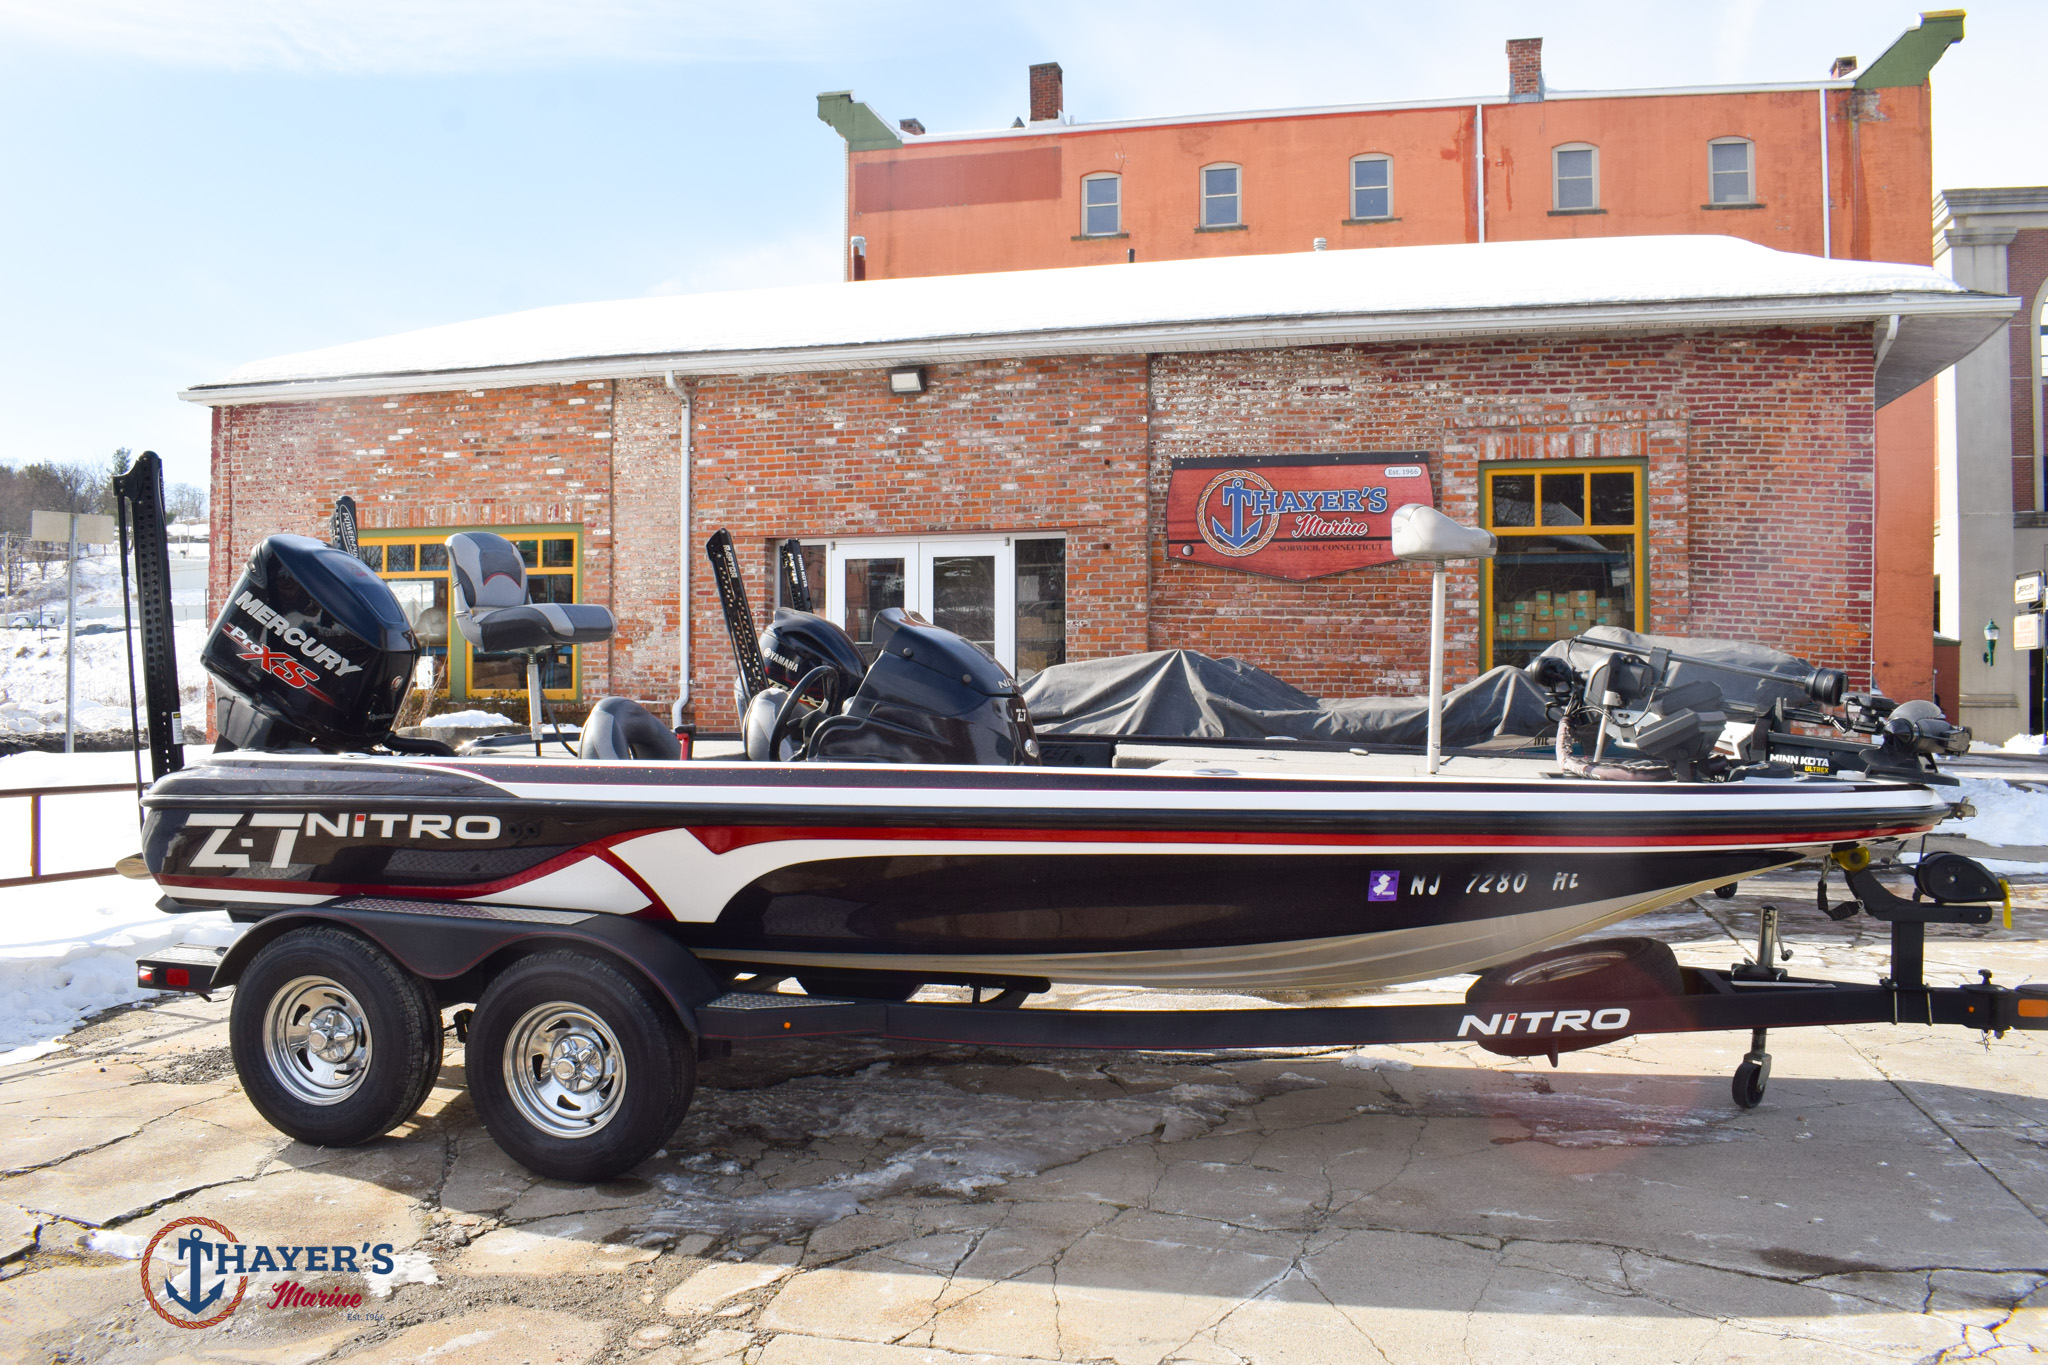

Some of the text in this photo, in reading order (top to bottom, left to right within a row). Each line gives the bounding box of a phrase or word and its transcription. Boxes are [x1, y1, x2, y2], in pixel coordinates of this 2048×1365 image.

[1291, 514, 1369, 538] Marine
[1322, 543, 1384, 551] CONNECTICUT
[235, 591, 363, 677] MERCURY
[769, 650, 799, 673] YAMAHA
[1769, 753, 1830, 767] MINN KOTA
[1804, 765, 1829, 774] ULTREX
[1464, 871, 1529, 894] 7280
